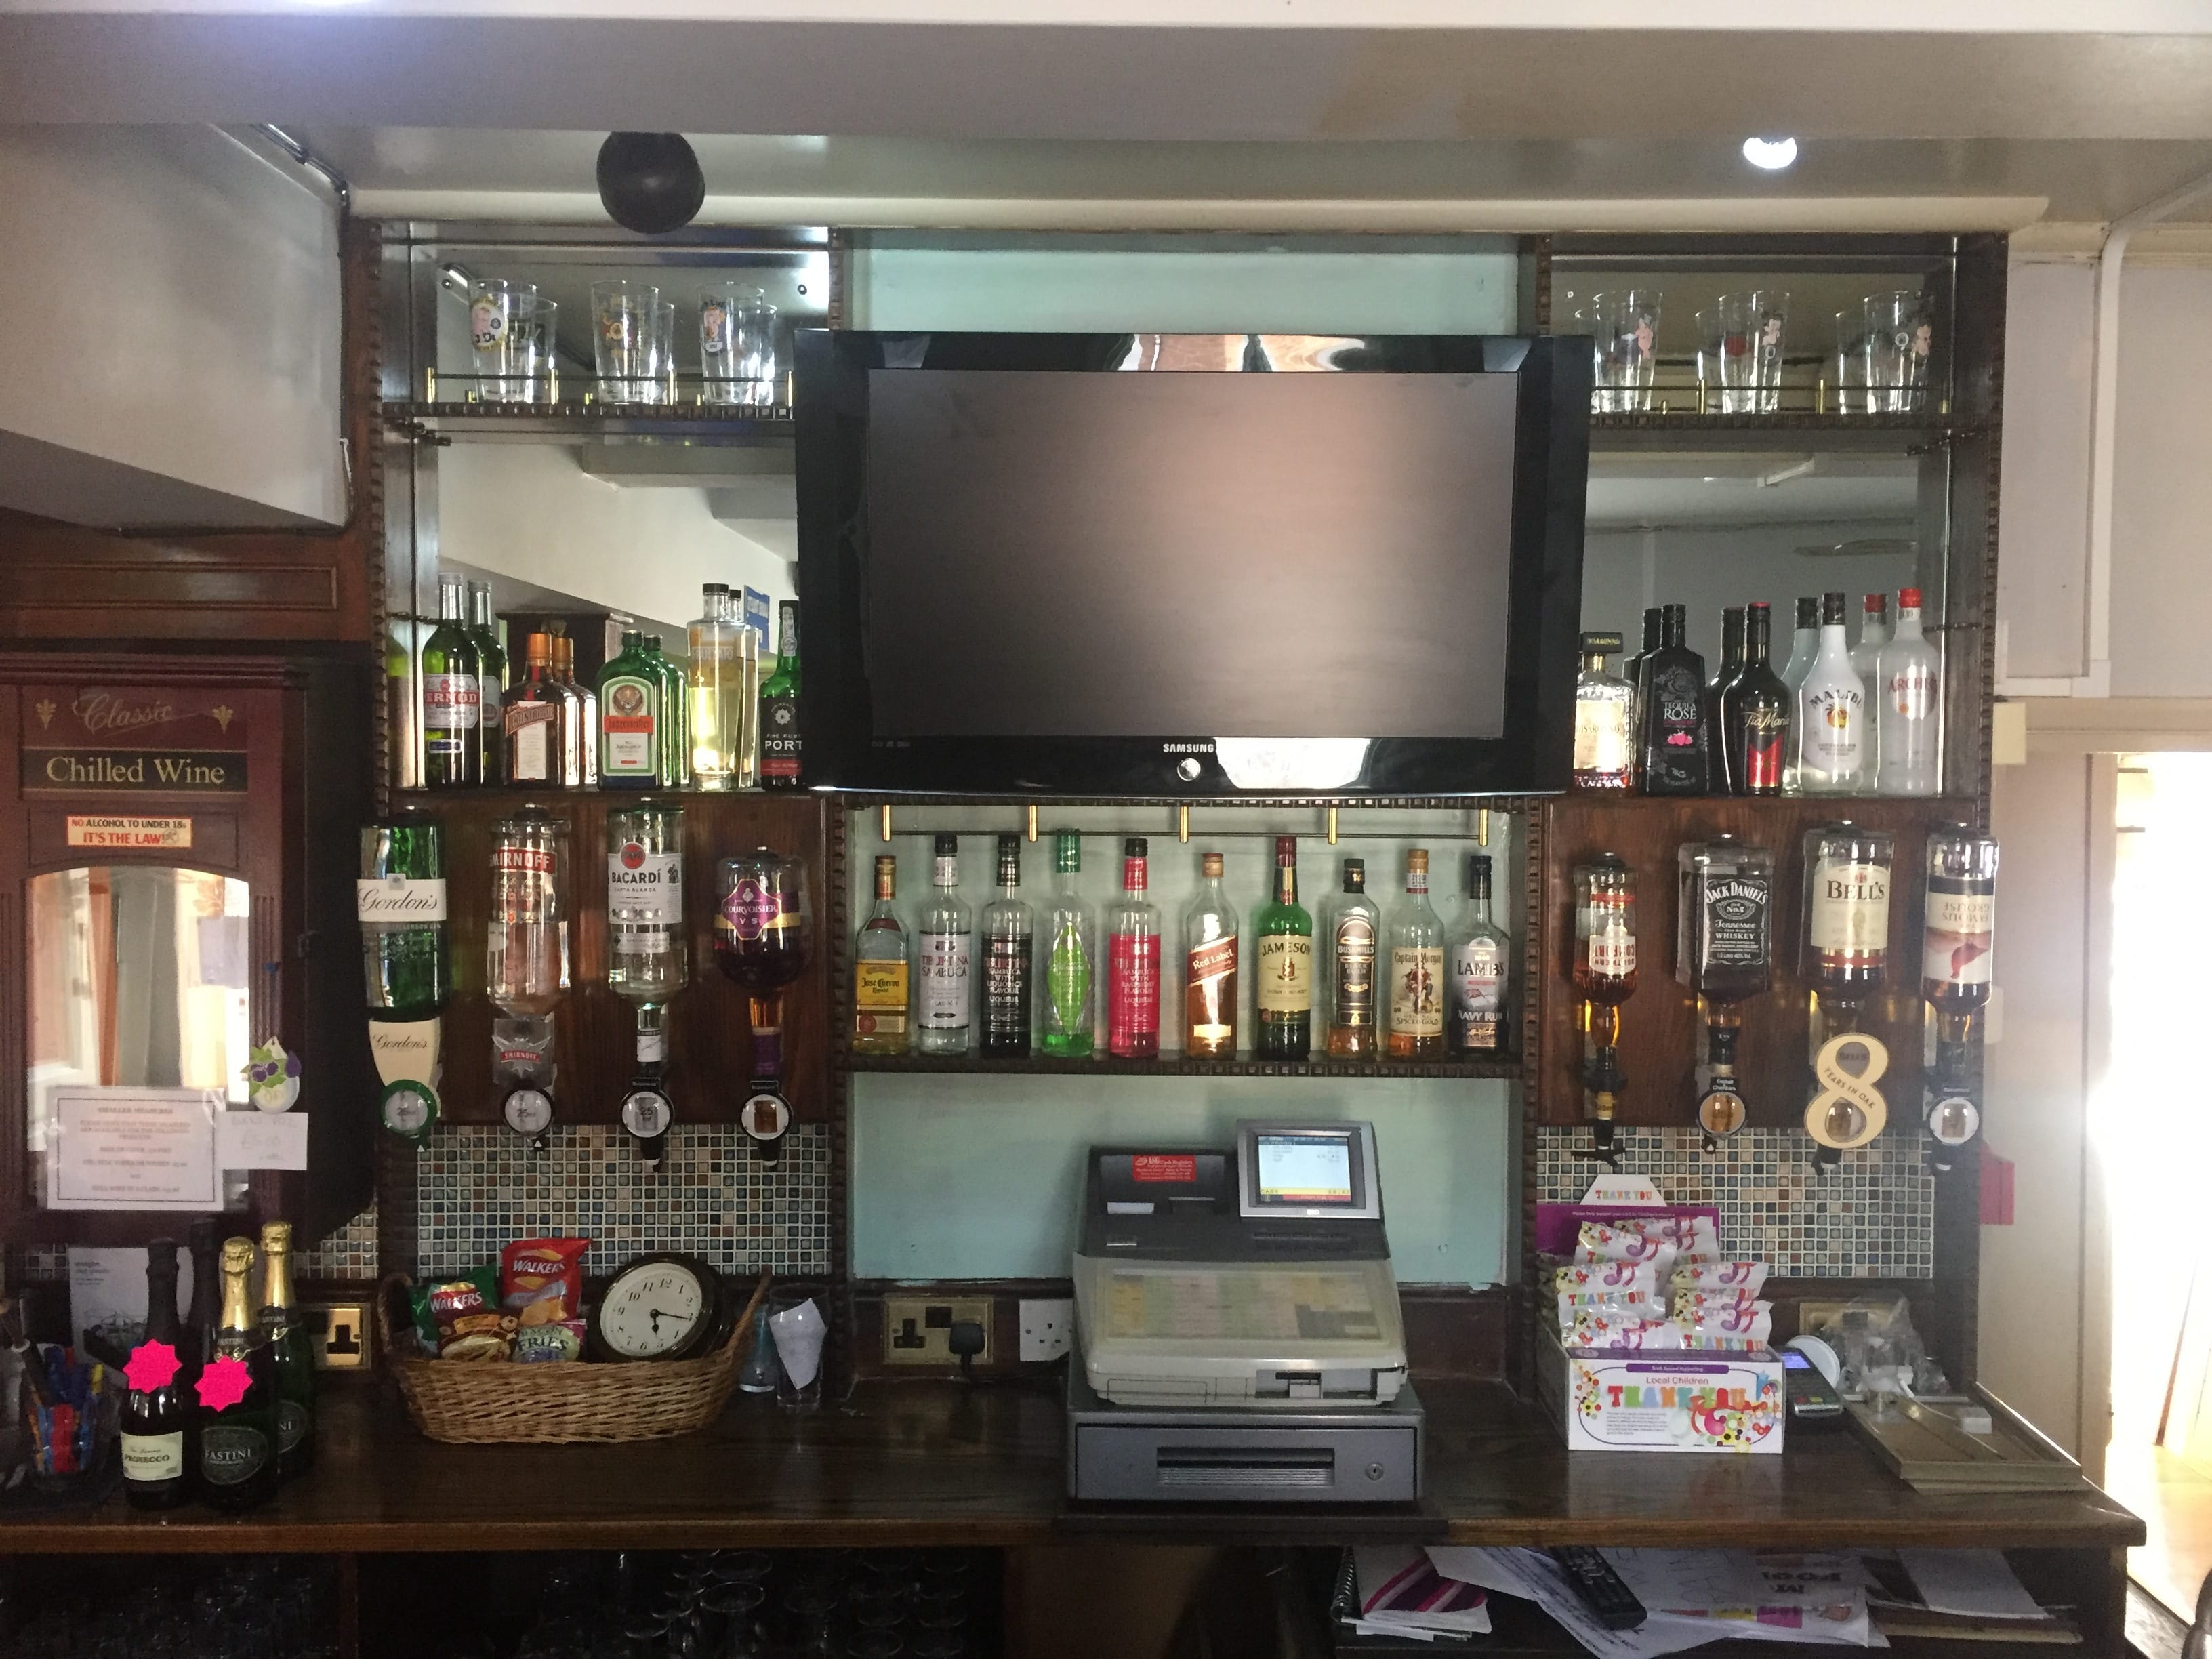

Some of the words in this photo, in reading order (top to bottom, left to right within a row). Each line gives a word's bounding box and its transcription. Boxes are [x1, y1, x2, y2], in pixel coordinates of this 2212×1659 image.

[426, 692, 477, 703] ERNOD
[72, 693, 174, 736] Classic
[1664, 708, 1697, 720] ROSE
[1742, 712, 1762, 728] Tia
[764, 740, 802, 750] PORT
[1162, 743, 1214, 753] SAMSUNG
[46, 756, 144, 783] Chilled
[154, 758, 226, 785] Wine
[71, 819, 85, 827] NO
[85, 819, 126, 828] ALCOHOL
[83, 832, 106, 844] IT'S
[108, 832, 131, 844] THE
[1704, 885, 1730, 903] JACK
[1730, 882, 1768, 905] DANIEL'S
[1826, 880, 1885, 900] BELL'S
[358, 888, 438, 912] Gordon's
[1262, 942, 1311, 956] JAMESON
[1193, 957, 1210, 970] Red
[1210, 949, 1233, 964] Label
[1394, 951, 1418, 964] Captain
[373, 1034, 428, 1049] Gordon's
[504, 1052, 538, 1060] SMIRNOFF
[1847, 1085, 1858, 1094] IN
[1595, 1190, 1631, 1200] THANK
[1633, 1191, 1652, 1200] YOU
[642, 1282, 653, 1292] 11
[659, 1277, 672, 1288] 12
[678, 1284, 684, 1294] 1
[430, 1292, 483, 1313] WALKERS
[628, 1292, 641, 1302] 10
[686, 1296, 693, 1307] 2
[617, 1306, 625, 1316] 9
[518, 1336, 569, 1352] FRIES
[640, 1340, 648, 1351] 6
[1646, 1376, 1670, 1385] Local
[1671, 1376, 1709, 1385] Children
[1607, 1385, 1694, 1409] THANK
[1699, 1387, 1747, 1409] YOU
